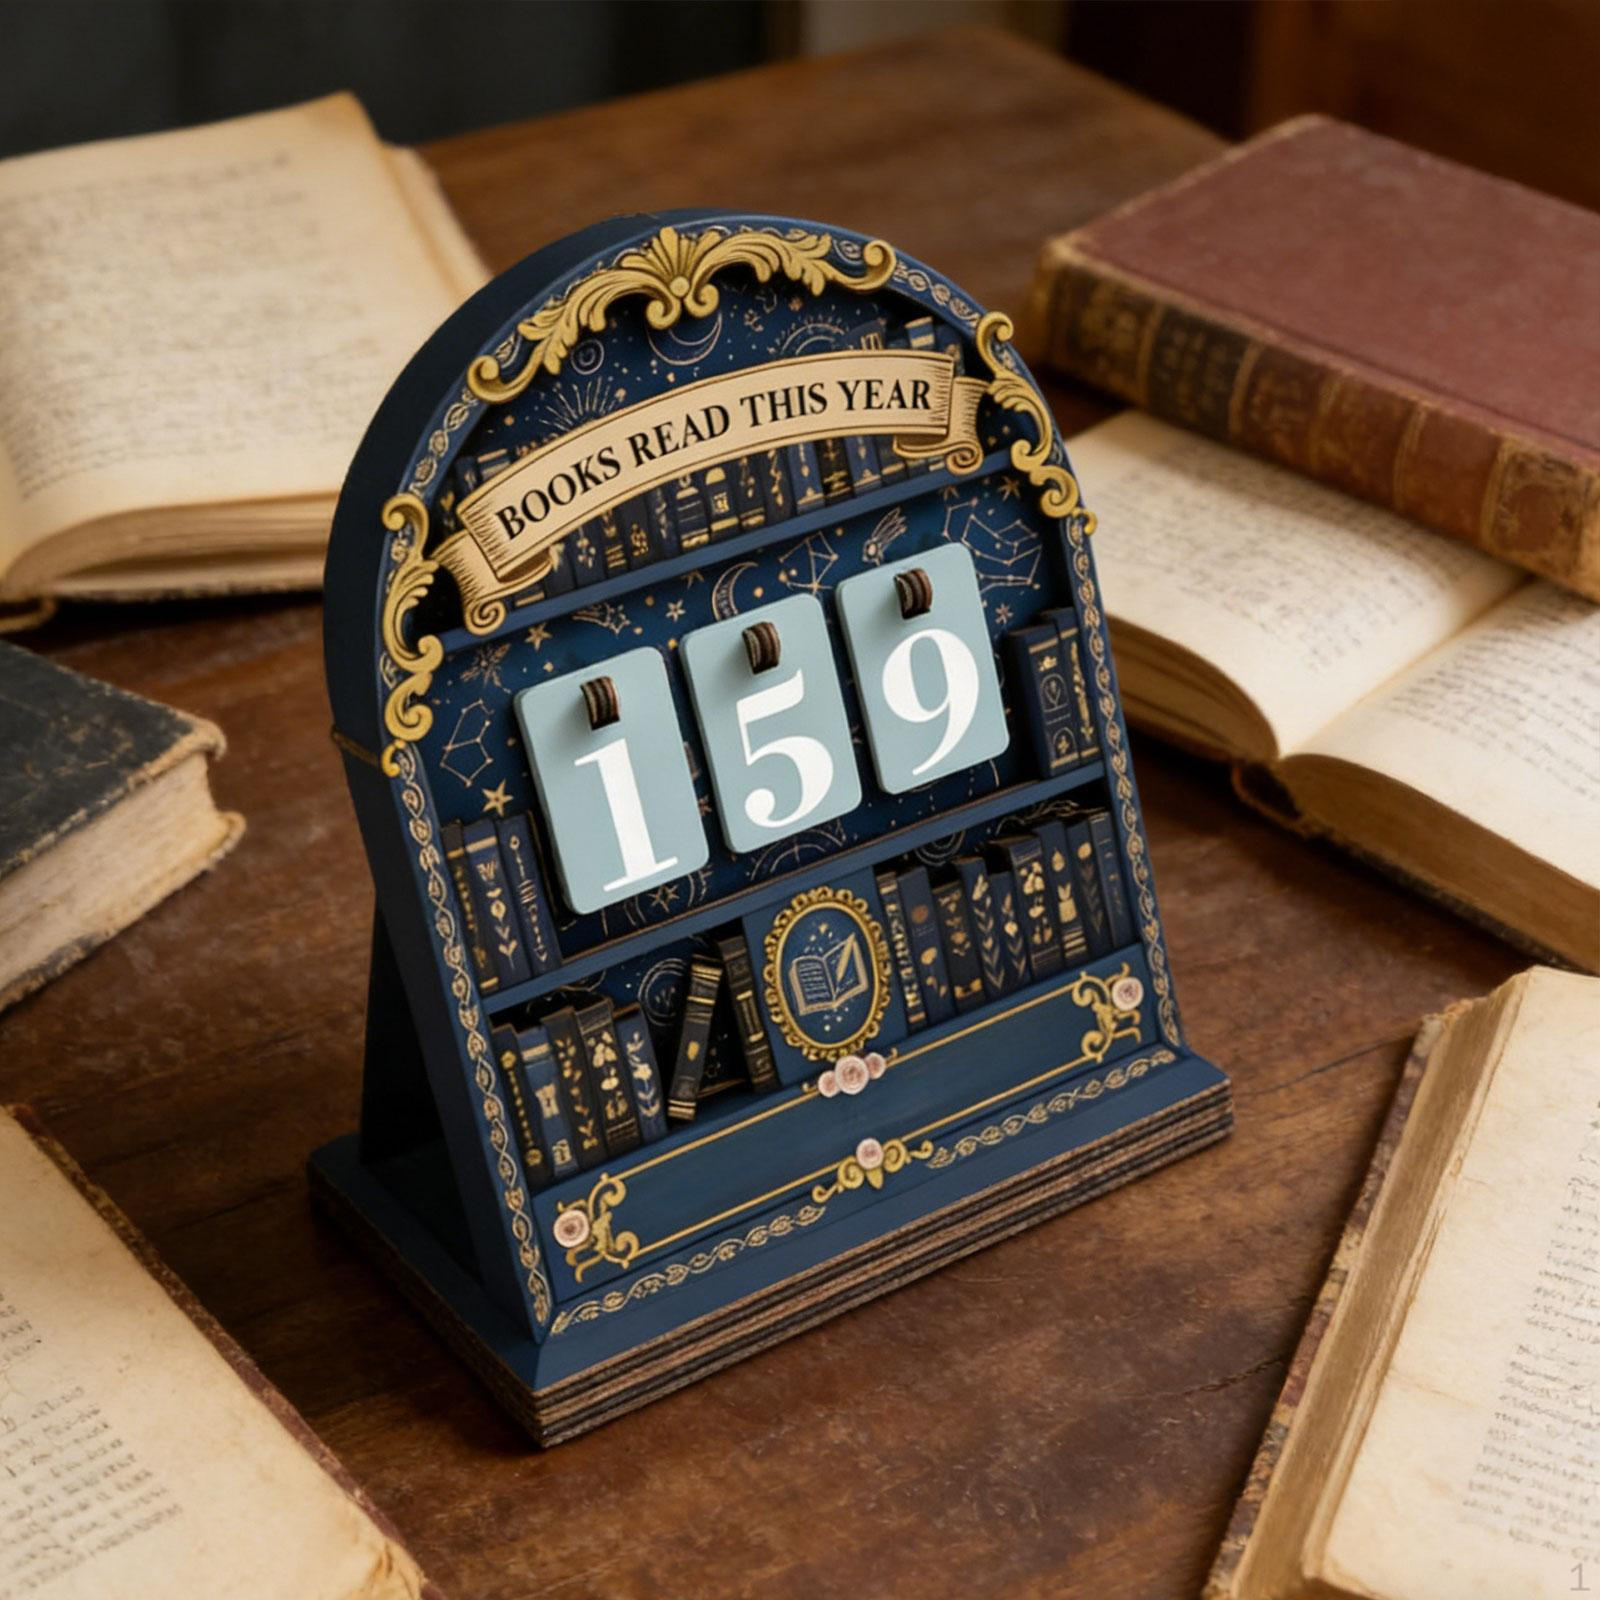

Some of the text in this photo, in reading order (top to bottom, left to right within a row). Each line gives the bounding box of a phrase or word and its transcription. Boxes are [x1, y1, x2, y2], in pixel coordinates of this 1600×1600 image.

[495, 378, 932, 541] BOOKS READ THIS YEAR
